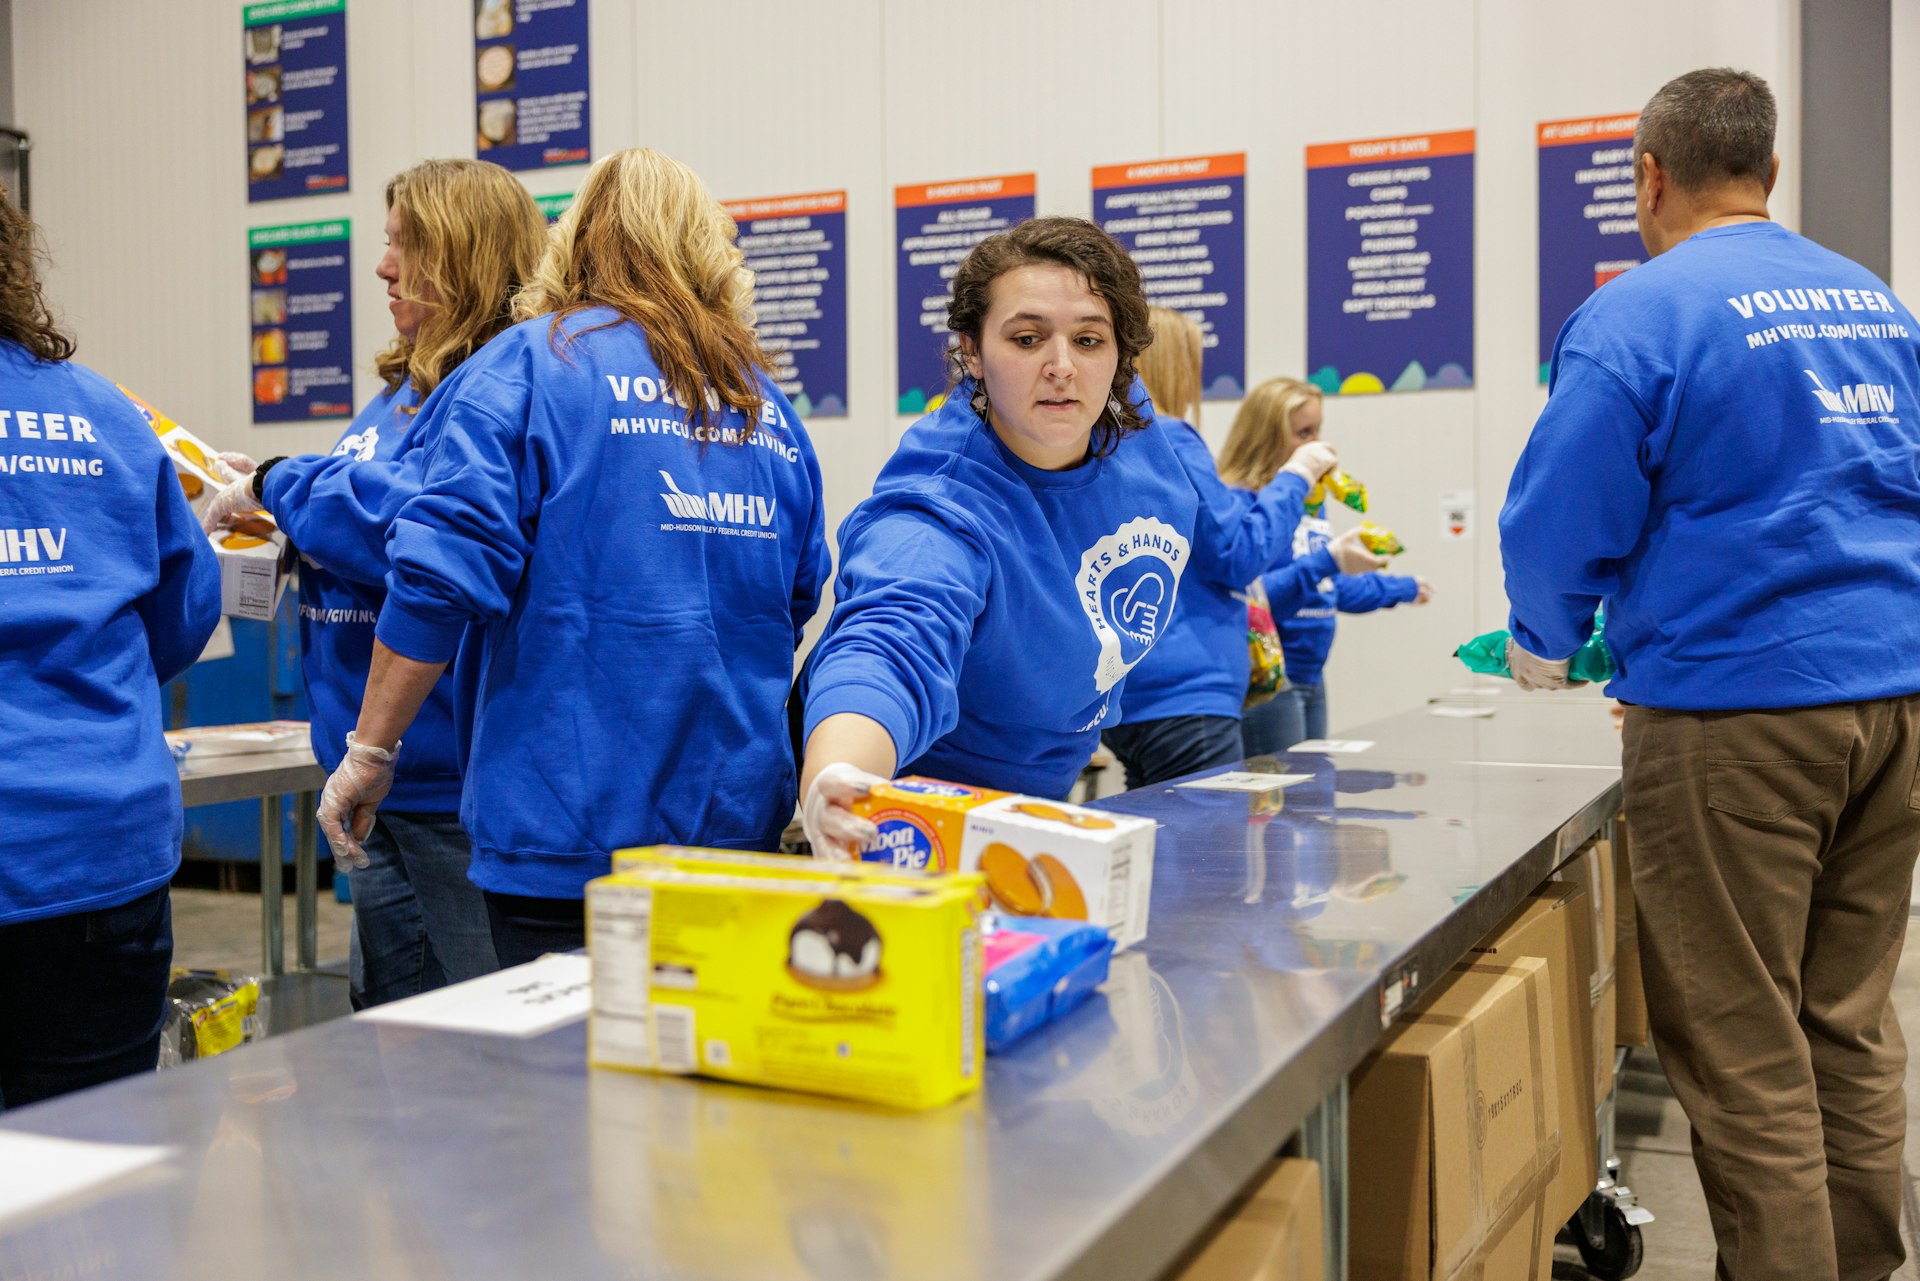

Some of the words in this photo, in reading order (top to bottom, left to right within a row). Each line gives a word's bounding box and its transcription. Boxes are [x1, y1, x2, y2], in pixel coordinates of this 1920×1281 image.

[1348, 143, 1397, 158] TODAY'S
[1400, 137, 1430, 152] DATE
[1727, 288, 1896, 320] VOLUNTEER
[1745, 323, 1910, 350] MHVFCU.COM/GIVING
[1841, 383, 1896, 414] MHV
[707, 491, 777, 528] MHV
[0, 527, 66, 563] HV
[47, 564, 73, 574] UNION
[1085, 552, 1112, 631] HEARTS
[1118, 543, 1130, 558] &
[1132, 533, 1181, 562] HANDS
[892, 844, 927, 872] Pie
